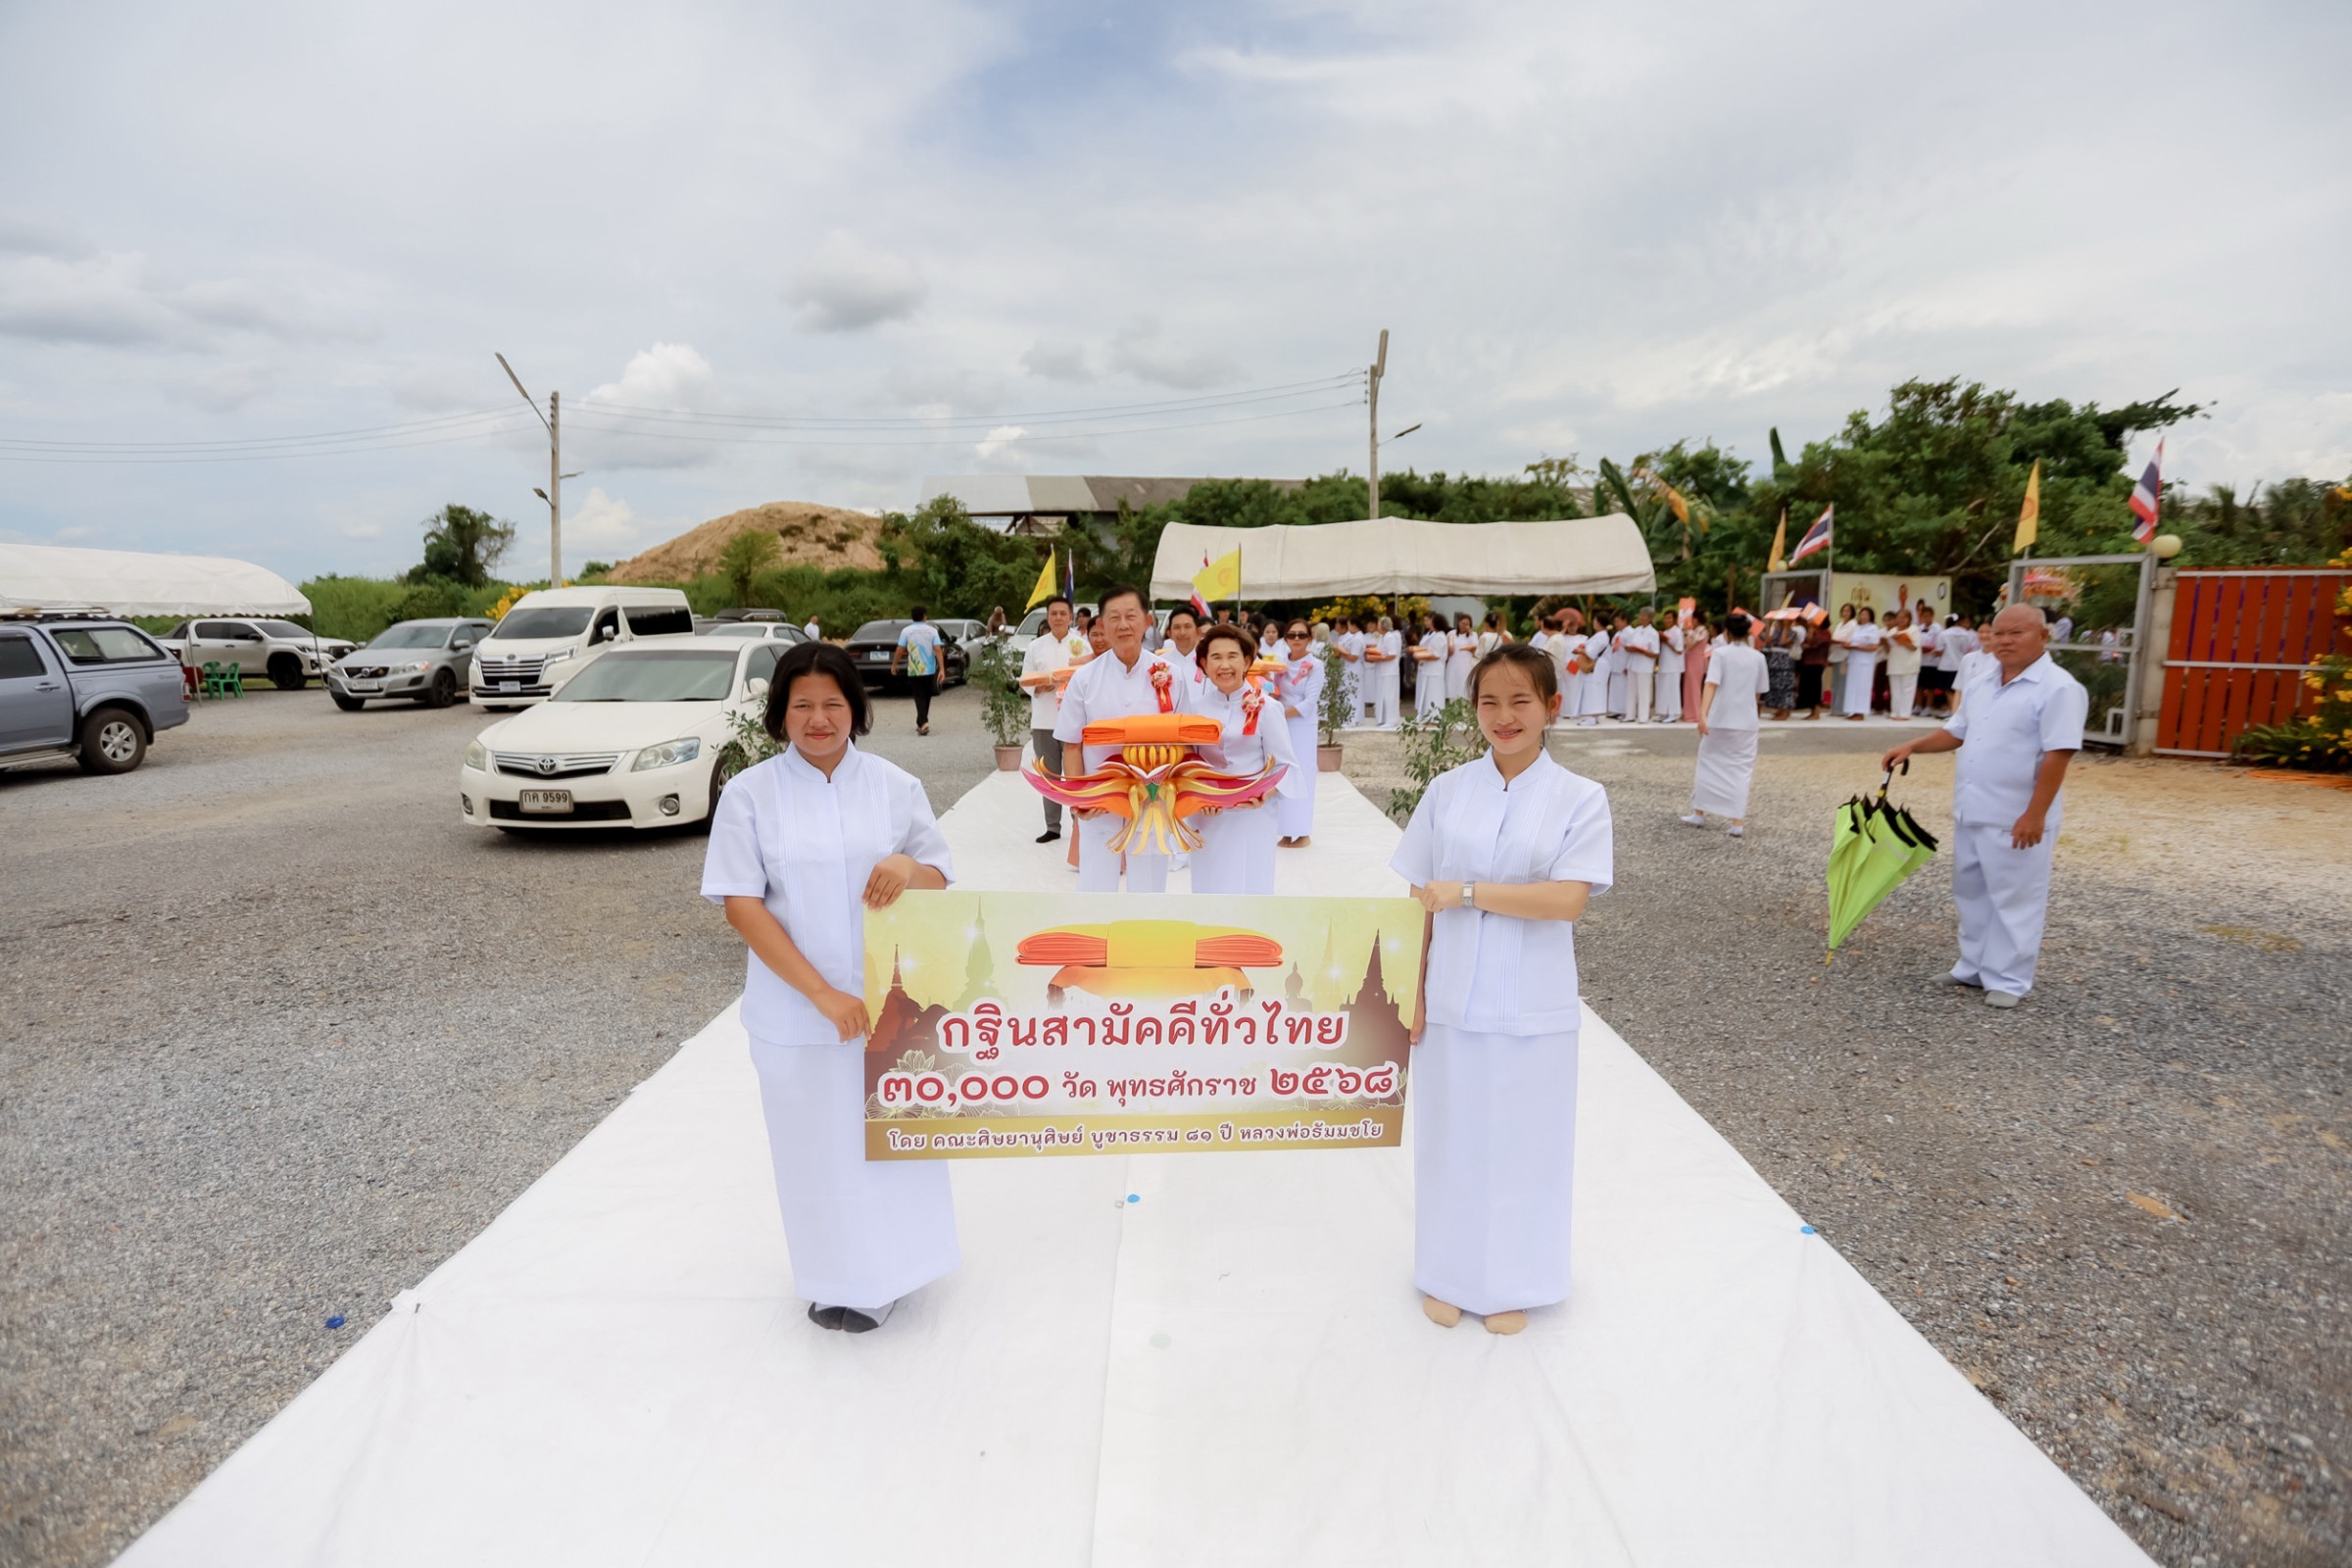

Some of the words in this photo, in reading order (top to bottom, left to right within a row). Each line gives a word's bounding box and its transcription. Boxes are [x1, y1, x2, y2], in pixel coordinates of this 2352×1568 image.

[542, 792, 567, 803] 9599
[943, 990, 1344, 1060] กฐินสามัคคีทั่วไทย
[883, 1075, 1050, 1107] ๓๐,๐๐๐
[1062, 1071, 1097, 1099] วัด
[1106, 1070, 1256, 1107] พุทธศักราช
[1270, 1066, 1394, 1096] ๒๕๖๘
[888, 1130, 925, 1149] โดย
[934, 1125, 1083, 1152] คณะศิษยานุศิษย์
[1091, 1129, 1178, 1150] บูชาธรรม
[1186, 1130, 1212, 1142] ๘๑
[1219, 1123, 1232, 1141] ปี
[1240, 1120, 1382, 1141] หลวงพ่อธัมมชโย
